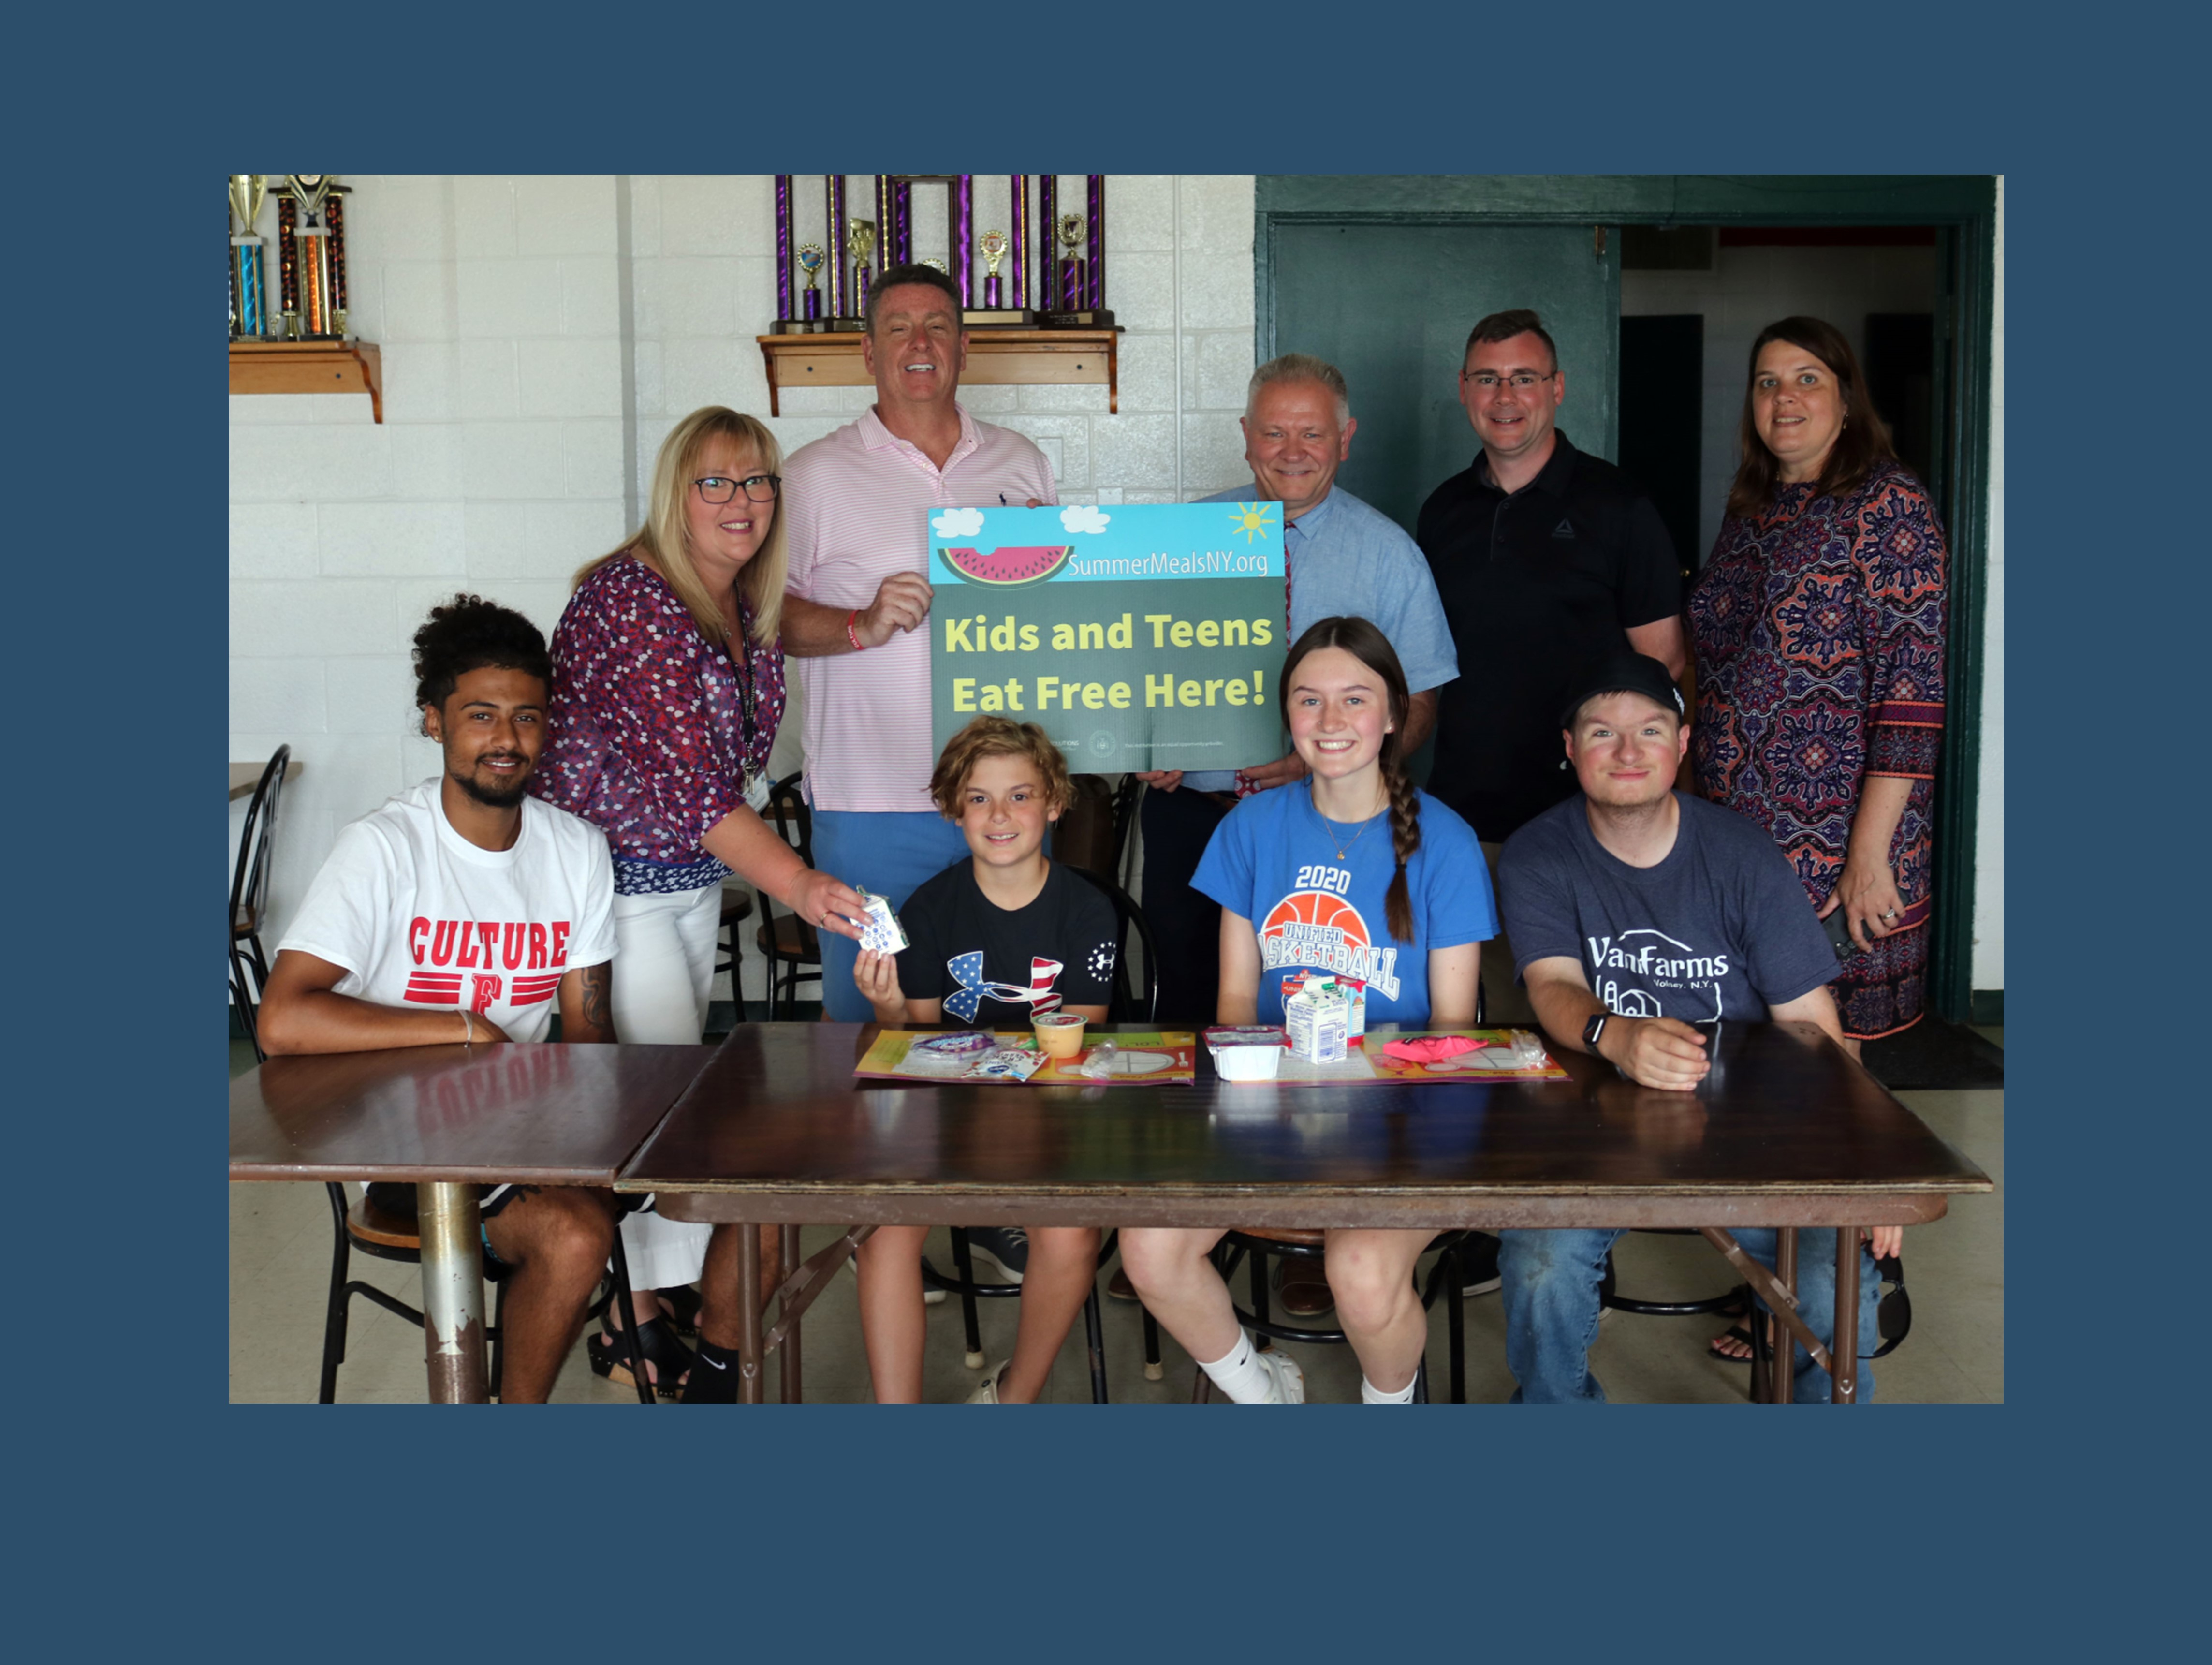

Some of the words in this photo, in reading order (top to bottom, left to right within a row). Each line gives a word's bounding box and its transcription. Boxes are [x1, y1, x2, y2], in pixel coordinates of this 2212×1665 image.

[1068, 550, 1269, 577] SummerMealsNY.org
[945, 614, 1040, 652] Kids
[1051, 613, 1133, 650] and
[1145, 614, 1273, 648] Teens
[953, 678, 1024, 712] Eat
[1037, 677, 1132, 710] Free
[1145, 670, 1265, 708] Here!
[1295, 865, 1351, 895] 2020
[410, 916, 570, 970] CULTURE
[1284, 923, 1343, 943] UNIFIED
[1257, 933, 1400, 1002] SKETBALL
[1690, 980, 1713, 989] N.Y.
